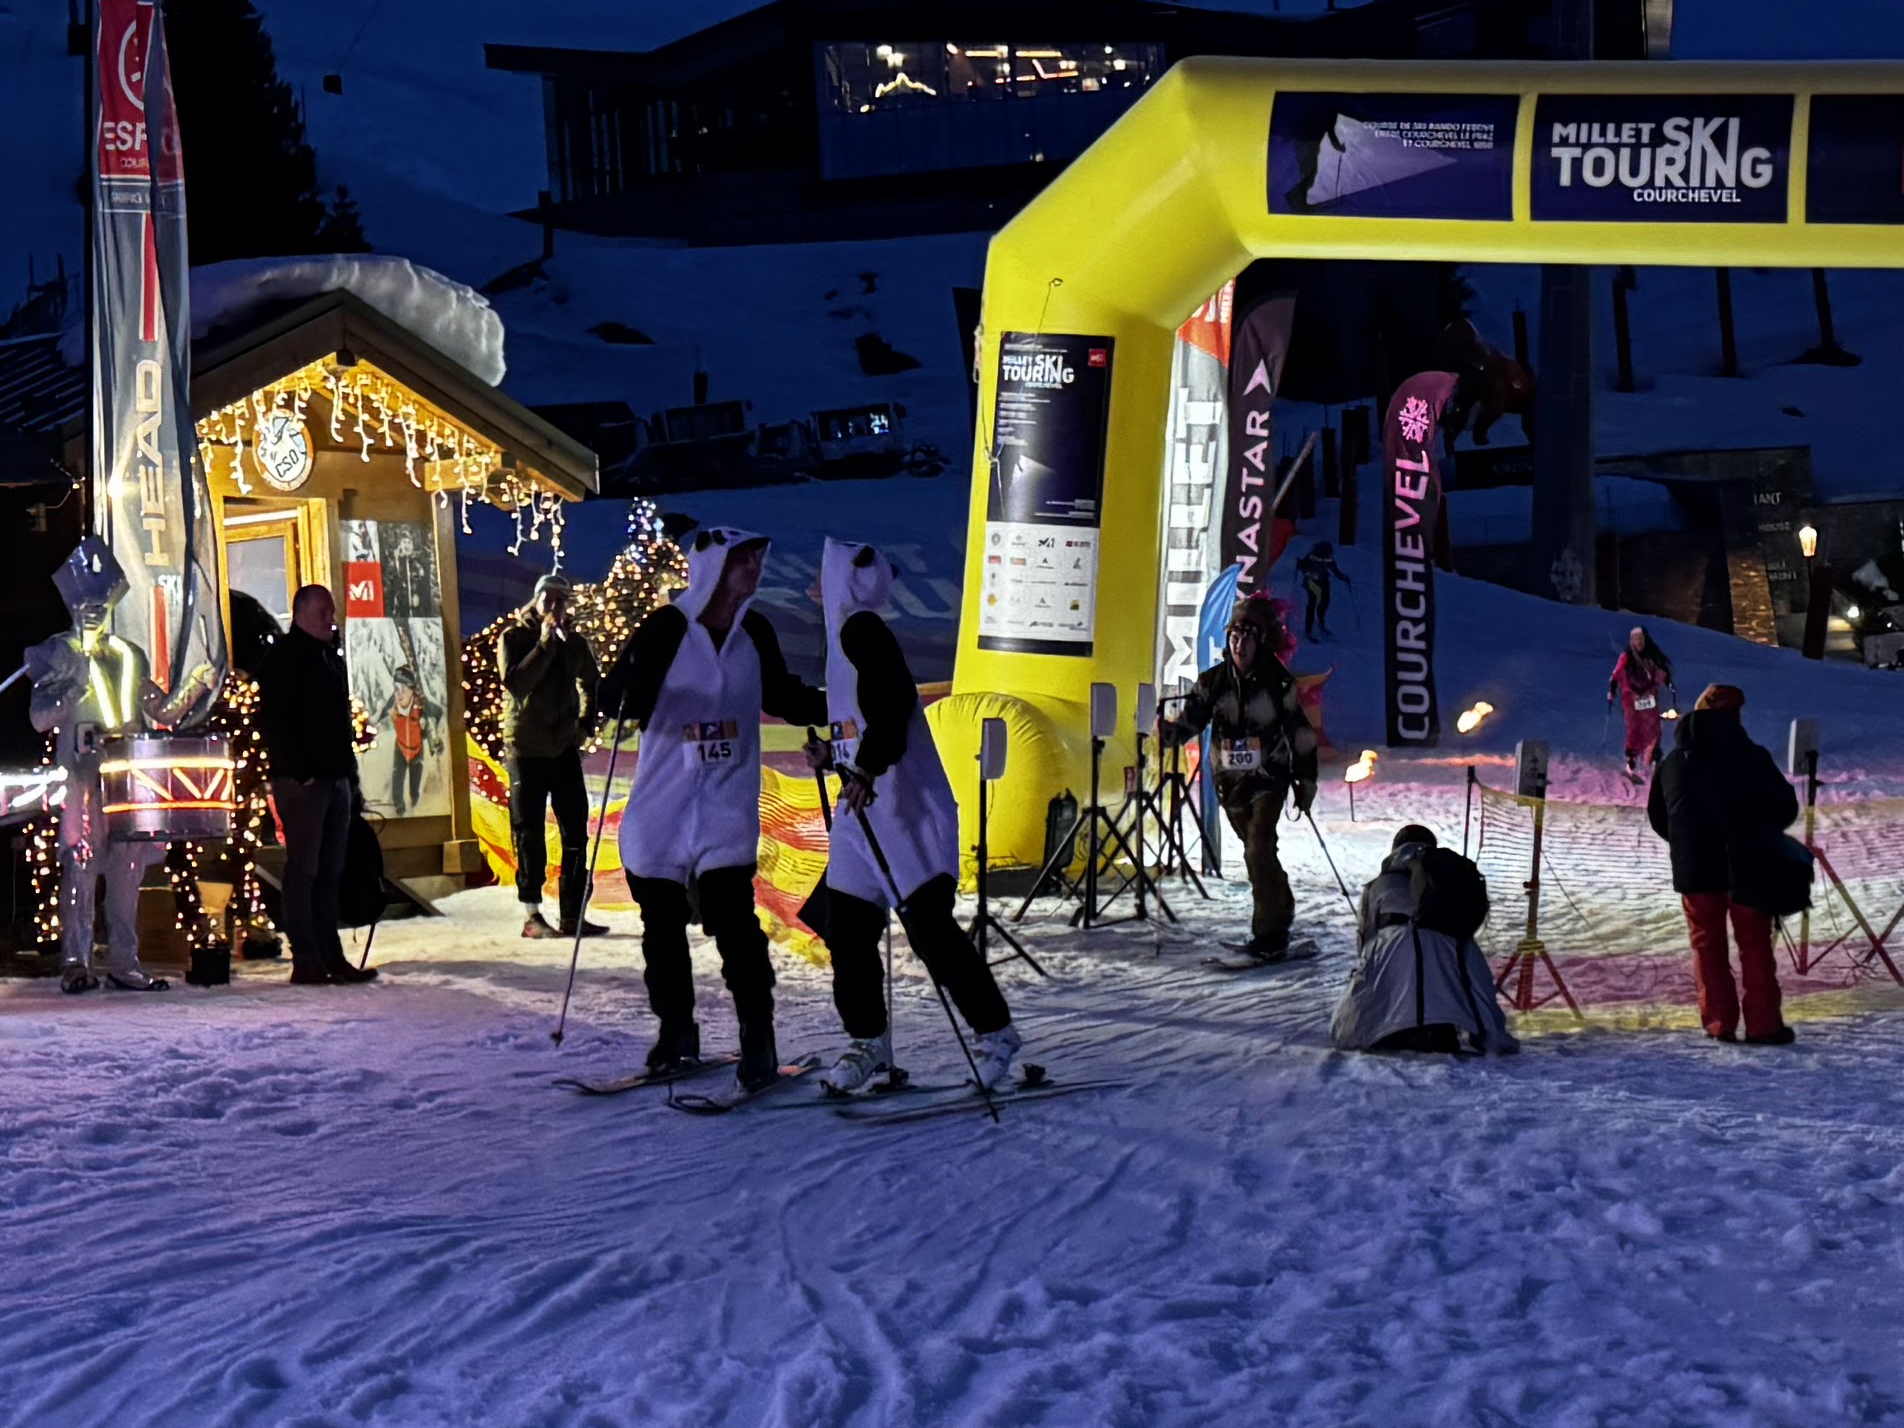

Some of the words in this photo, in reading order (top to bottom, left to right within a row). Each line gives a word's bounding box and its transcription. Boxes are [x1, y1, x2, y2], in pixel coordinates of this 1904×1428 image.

[1552, 122, 1657, 144] MILLET
[1662, 116, 1741, 154] SKI
[1550, 146, 1775, 189] TOURING
[1633, 188, 1742, 204] COURCHEVEL
[1002, 364, 1075, 384] TOURING
[1035, 354, 1064, 370] SKI
[138, 360, 170, 568] HEAD
[1161, 386, 1227, 687] MILLET
[1393, 449, 1433, 742] COURCHEVEL
[697, 741, 732, 762] 145
